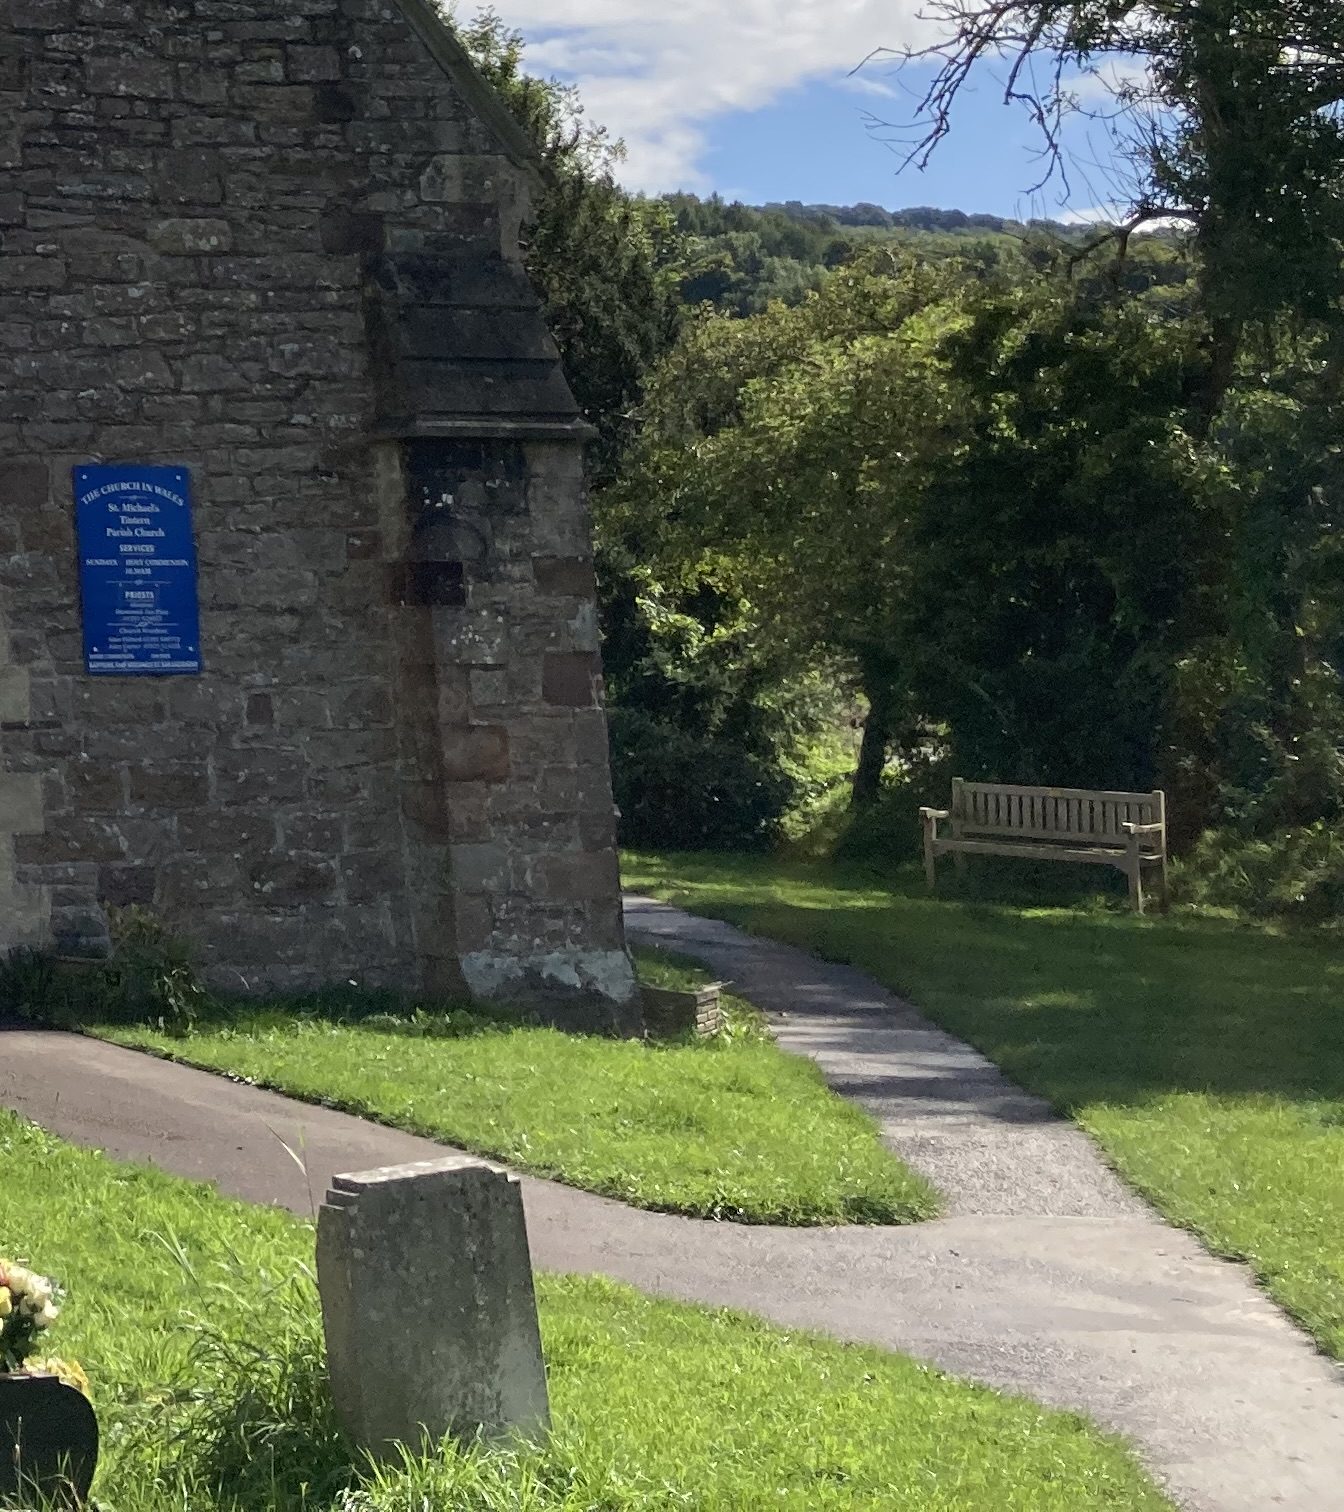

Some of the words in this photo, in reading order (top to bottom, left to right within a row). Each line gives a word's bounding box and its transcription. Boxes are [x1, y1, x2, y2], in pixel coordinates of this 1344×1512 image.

[80, 488, 101, 505] THE
[100, 481, 141, 495] CHURCH
[142, 482, 153, 492] IN
[154, 485, 185, 507] WALES
[107, 503, 120, 513] St.
[119, 515, 151, 525] Tintern
[106, 527, 133, 537] Parish
[134, 527, 166, 538] Church
[119, 544, 155, 553] SERVICES
